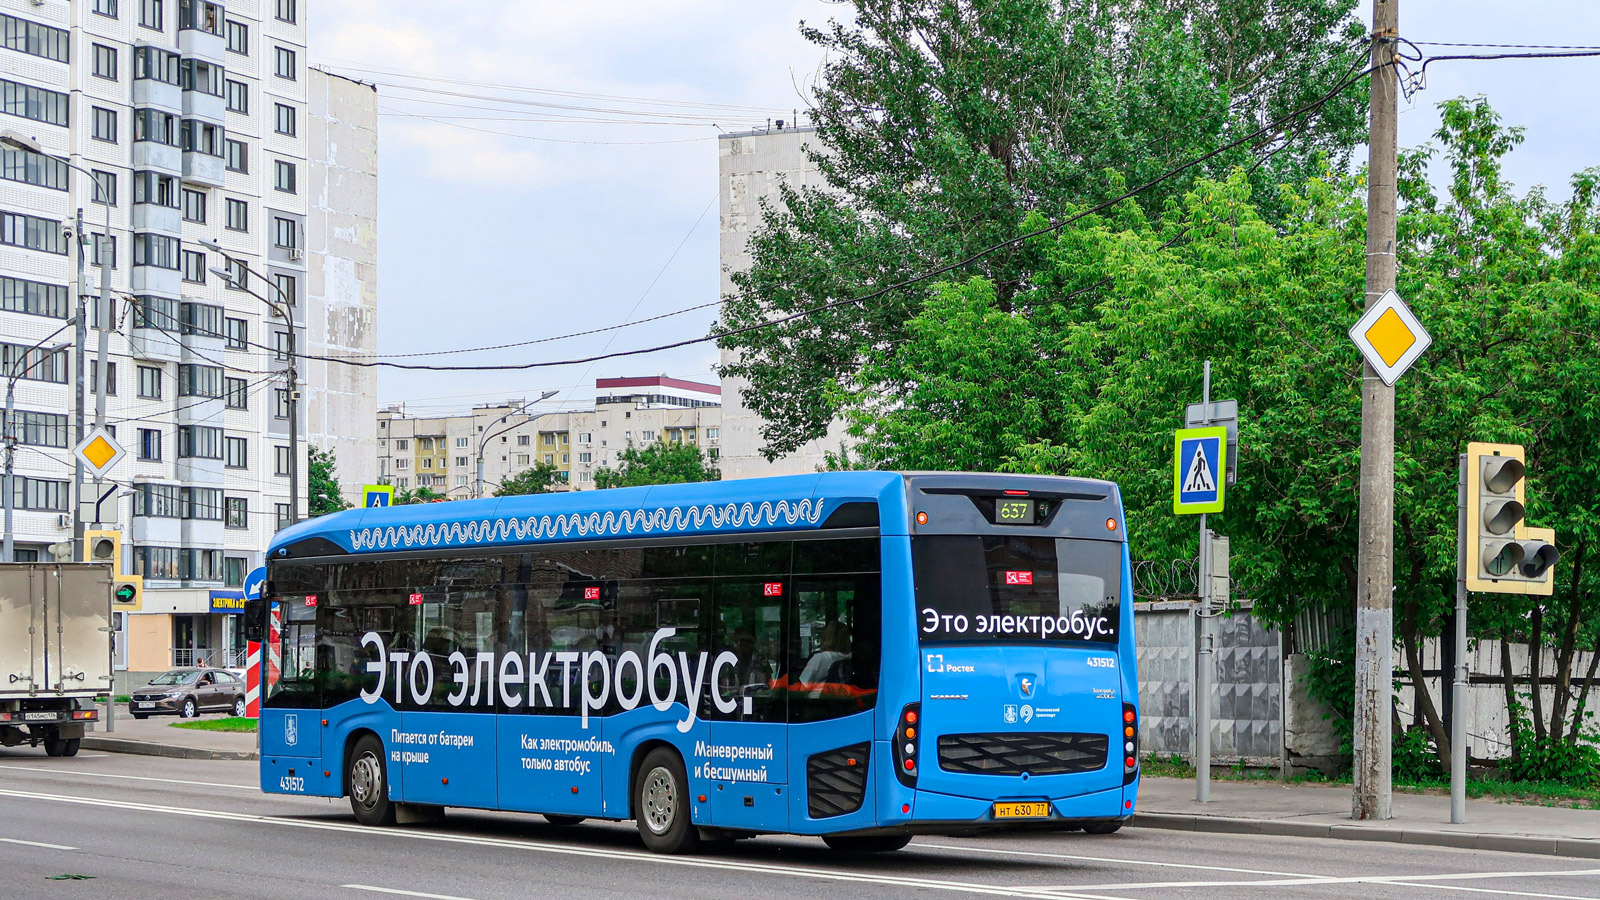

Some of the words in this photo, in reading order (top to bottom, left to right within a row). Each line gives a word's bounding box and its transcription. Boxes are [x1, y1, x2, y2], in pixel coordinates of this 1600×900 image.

[1001, 503, 1028, 519] 637
[922, 608, 969, 633] Это
[975, 610, 1114, 640] электробус.
[946, 664, 975, 672] Ростех
[1087, 657, 1115, 668] 431512
[360, 631, 434, 706] Это
[447, 627, 753, 733] электробус.
[391, 728, 427, 745] Питается
[428, 734, 438, 745] от
[439, 730, 474, 750] батареи
[521, 733, 538, 750] Как
[540, 735, 616, 756] электромобиль,
[391, 750, 400, 762] на
[402, 751, 429, 766] крыше
[694, 740, 774, 763] Маневренный
[521, 757, 552, 770] только
[554, 756, 591, 776] автобус
[694, 765, 702, 779] и
[703, 762, 767, 785] бесшумный
[280, 776, 305, 792] 431512
[999, 808, 1011, 816] НТ
[1014, 805, 1032, 816] 630
[1036, 804, 1045, 812] 77
